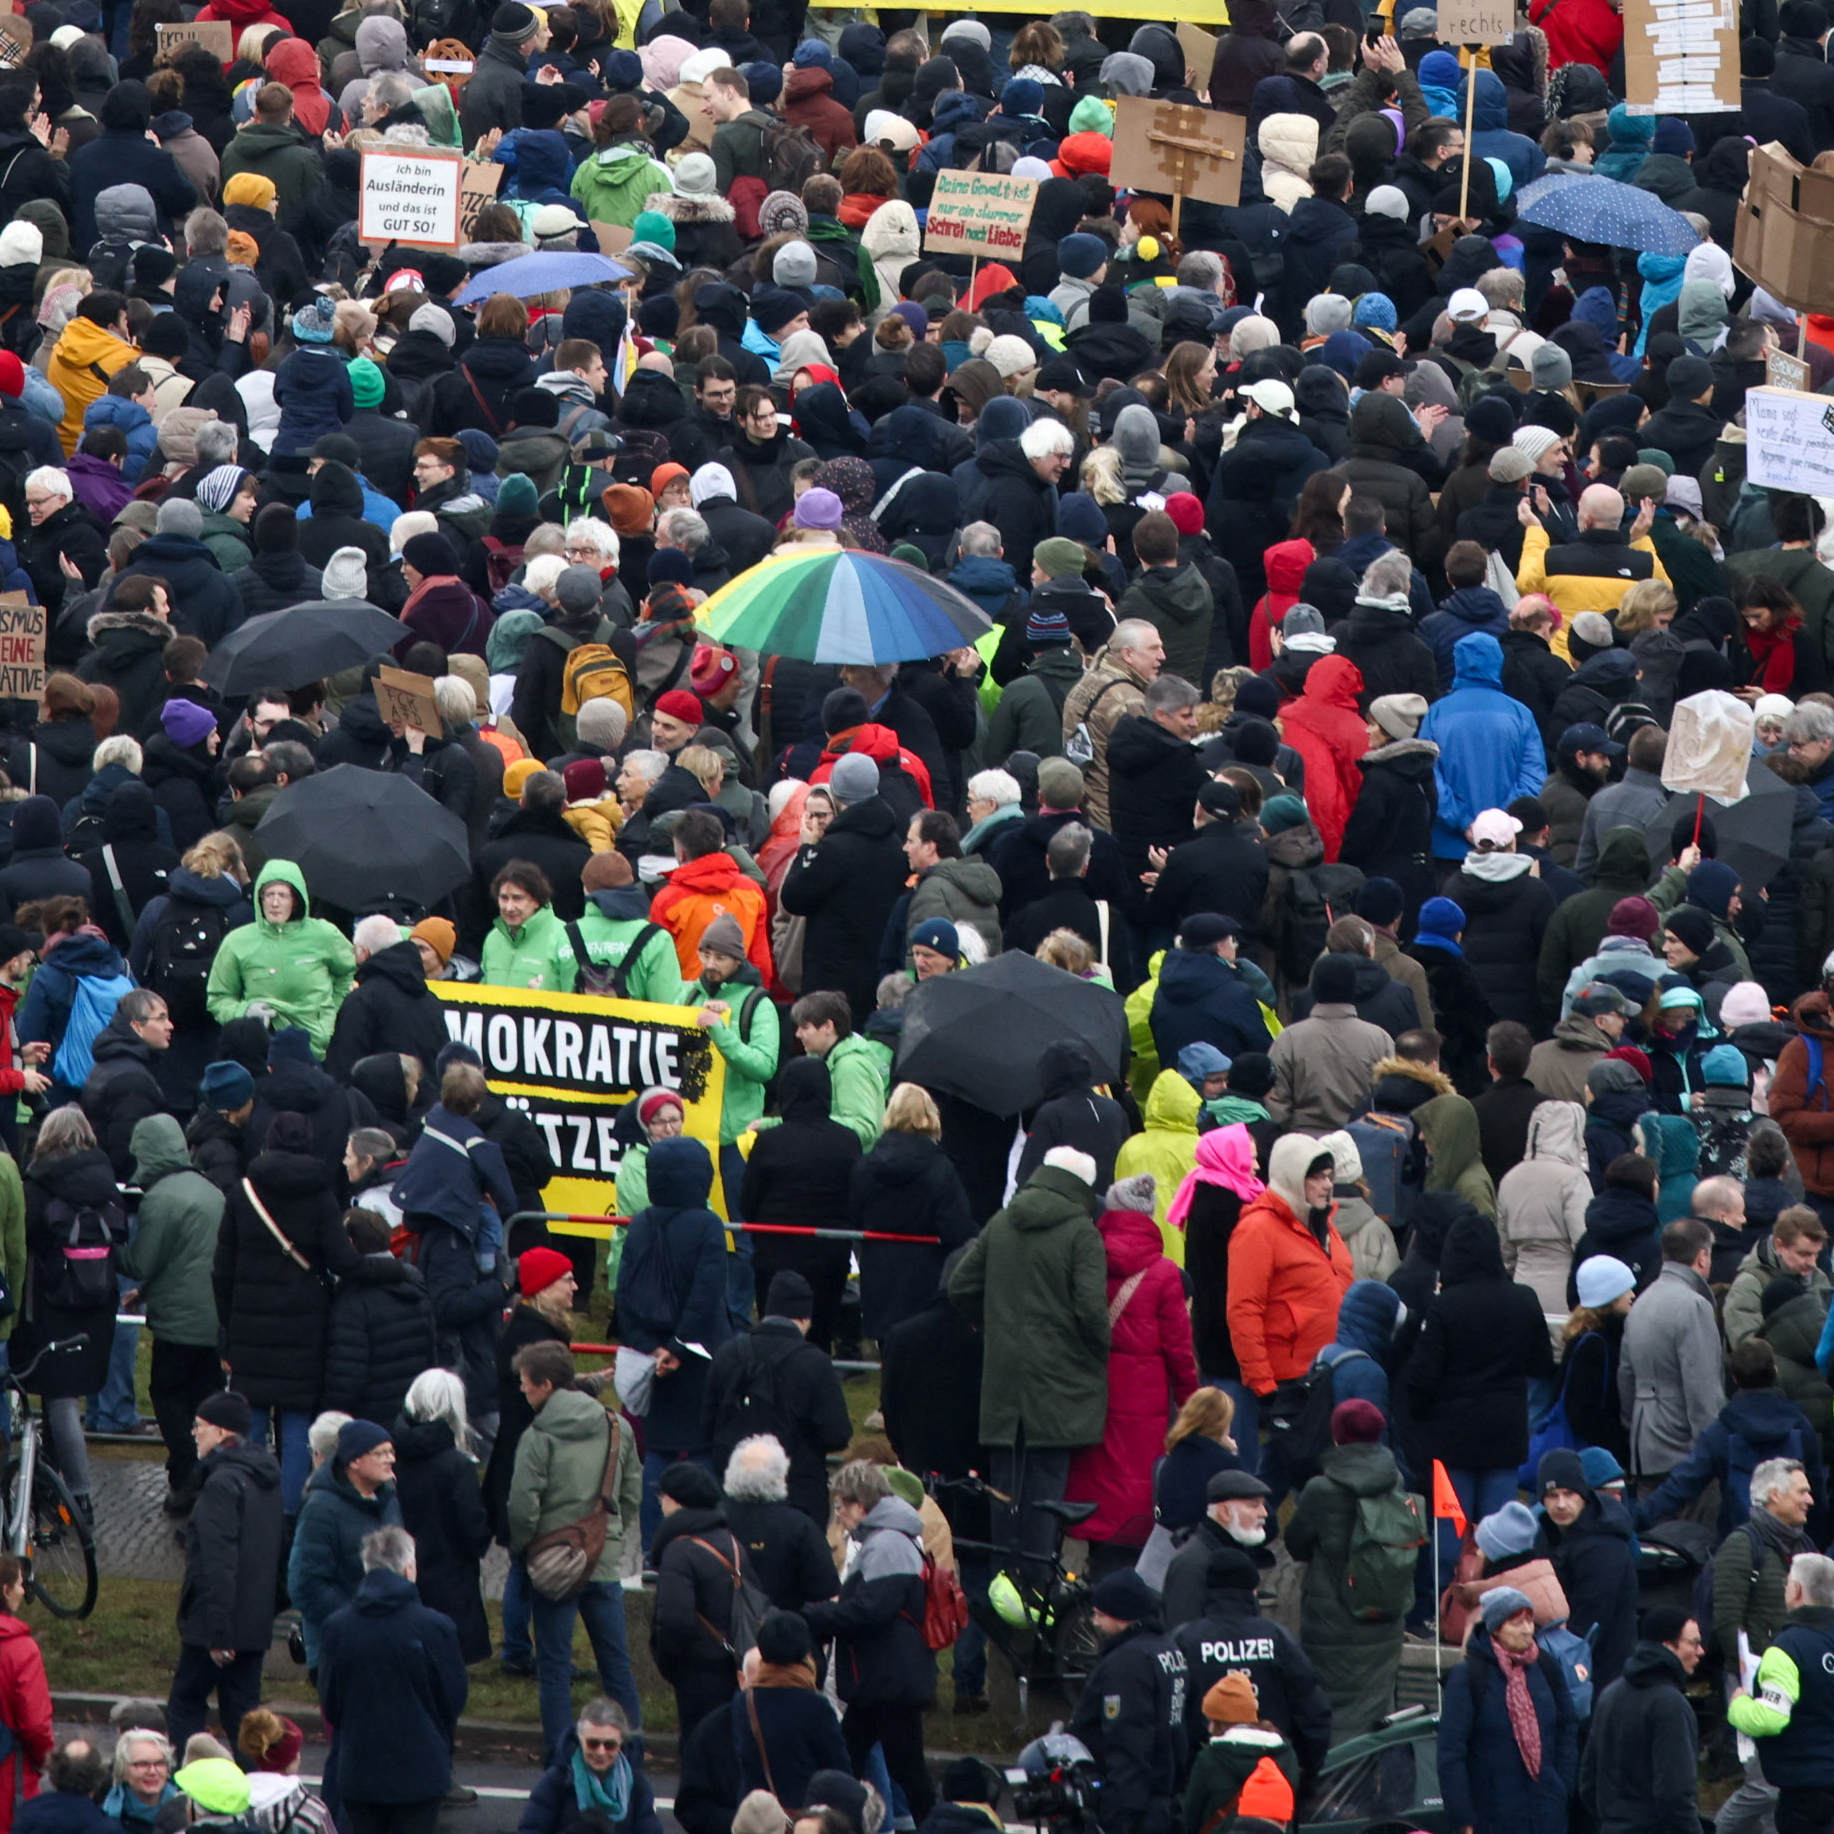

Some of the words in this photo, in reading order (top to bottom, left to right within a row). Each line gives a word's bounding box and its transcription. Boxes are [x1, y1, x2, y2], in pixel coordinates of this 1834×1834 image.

[1449, 13, 1504, 36] rechts
[396, 164, 412, 176] Ich
[414, 166, 432, 177] bin
[366, 178, 446, 197] Ausländerin
[937, 174, 971, 195] Deine
[971, 177, 1012, 200] Gewalt
[1013, 183, 1031, 200] ist
[378, 202, 401, 213] und
[402, 202, 421, 215] das
[423, 204, 437, 216] ist
[936, 203, 959, 215] nur
[976, 204, 1024, 224] stummer
[383, 217, 410, 232] GUT
[412, 219, 436, 235] SO!
[926, 216, 966, 239] Schrei
[987, 223, 1023, 248] Liebe
[1201, 1638, 1275, 1663] POLIZEI
